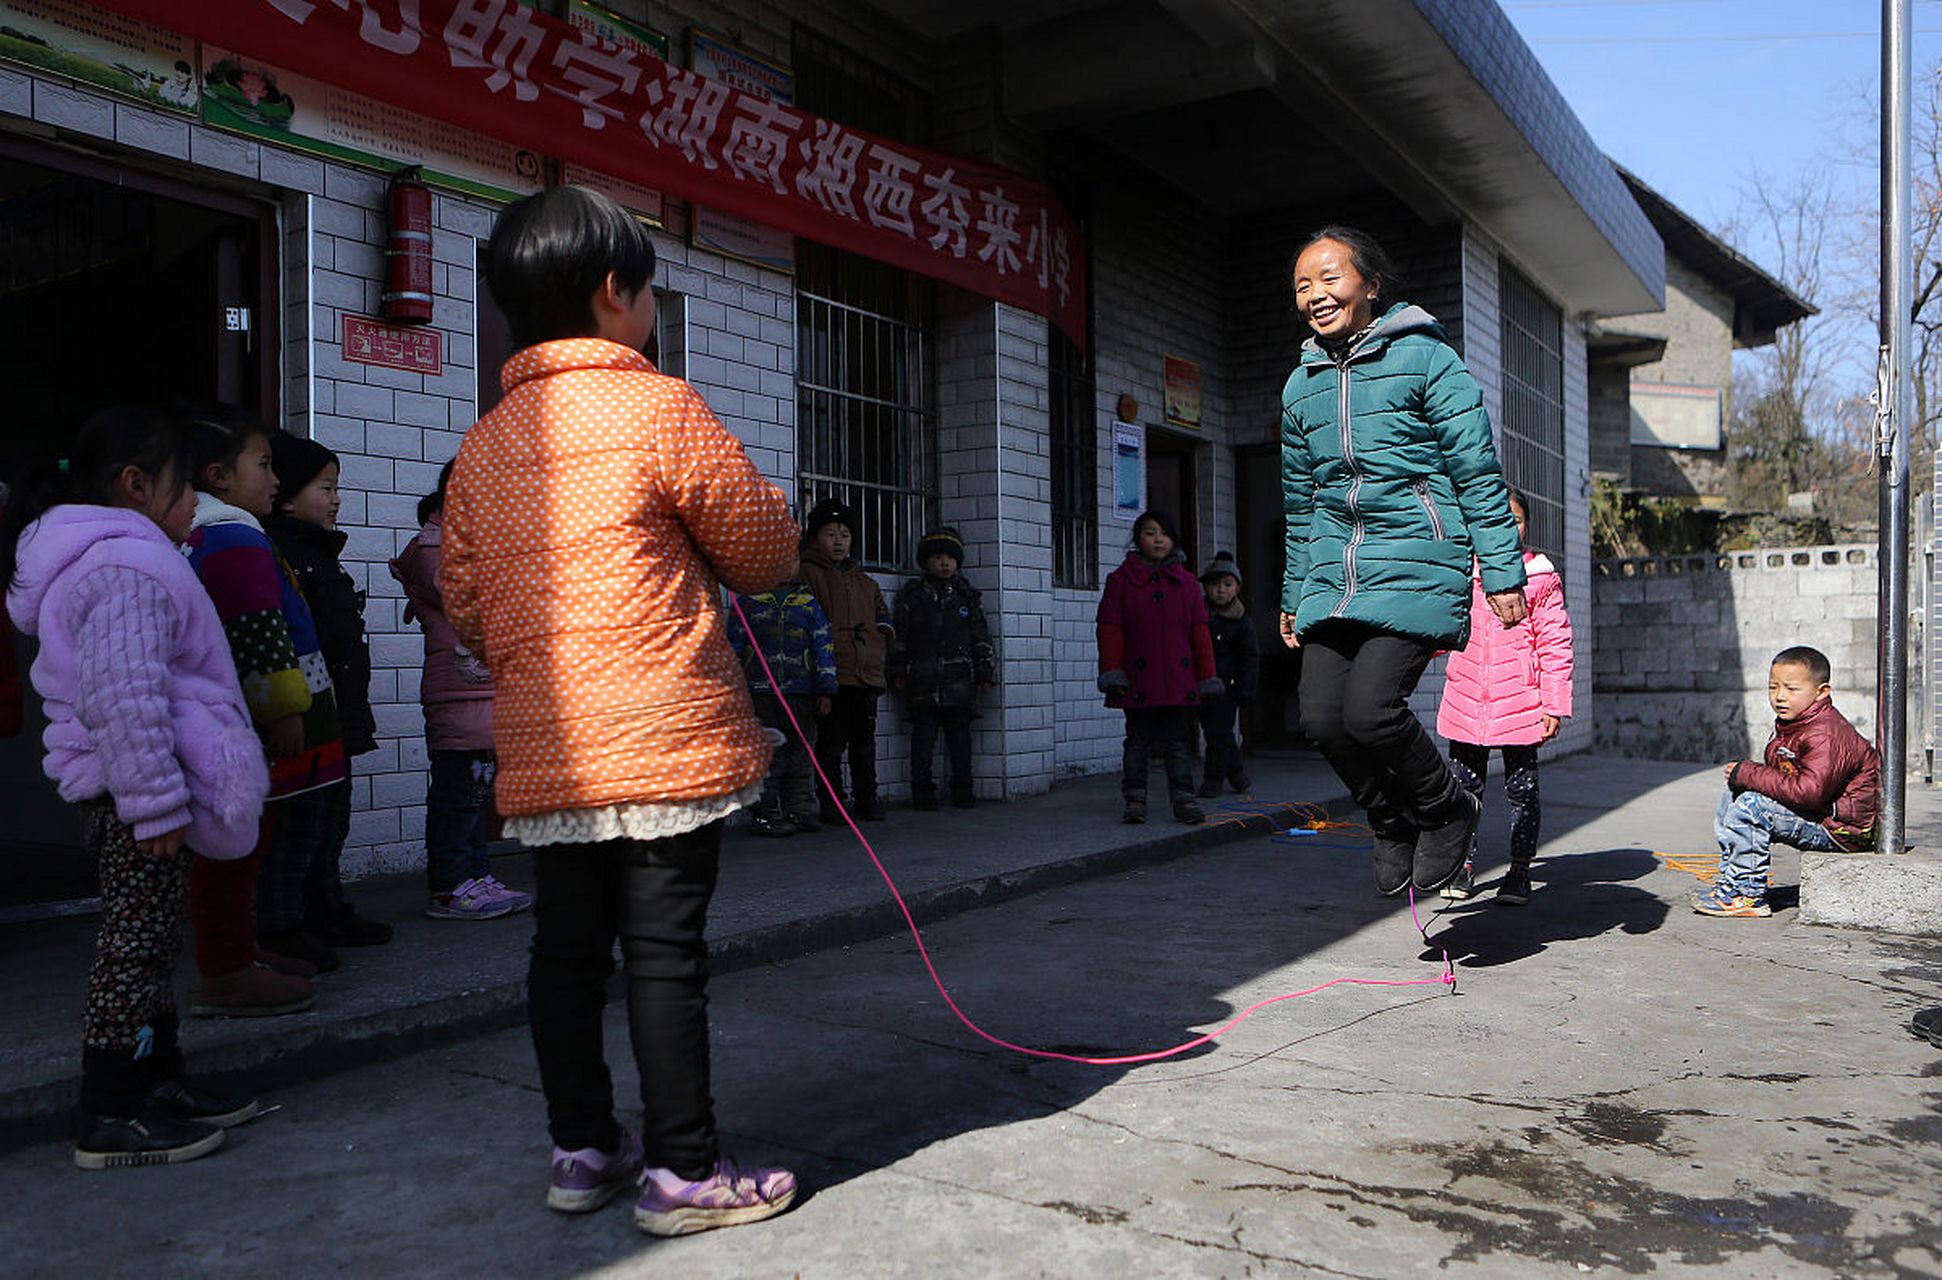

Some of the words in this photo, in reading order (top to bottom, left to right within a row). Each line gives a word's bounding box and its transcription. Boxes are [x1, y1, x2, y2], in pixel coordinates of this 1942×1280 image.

[266, 0, 1071, 308] 心助学湖南湘西夯来小学
